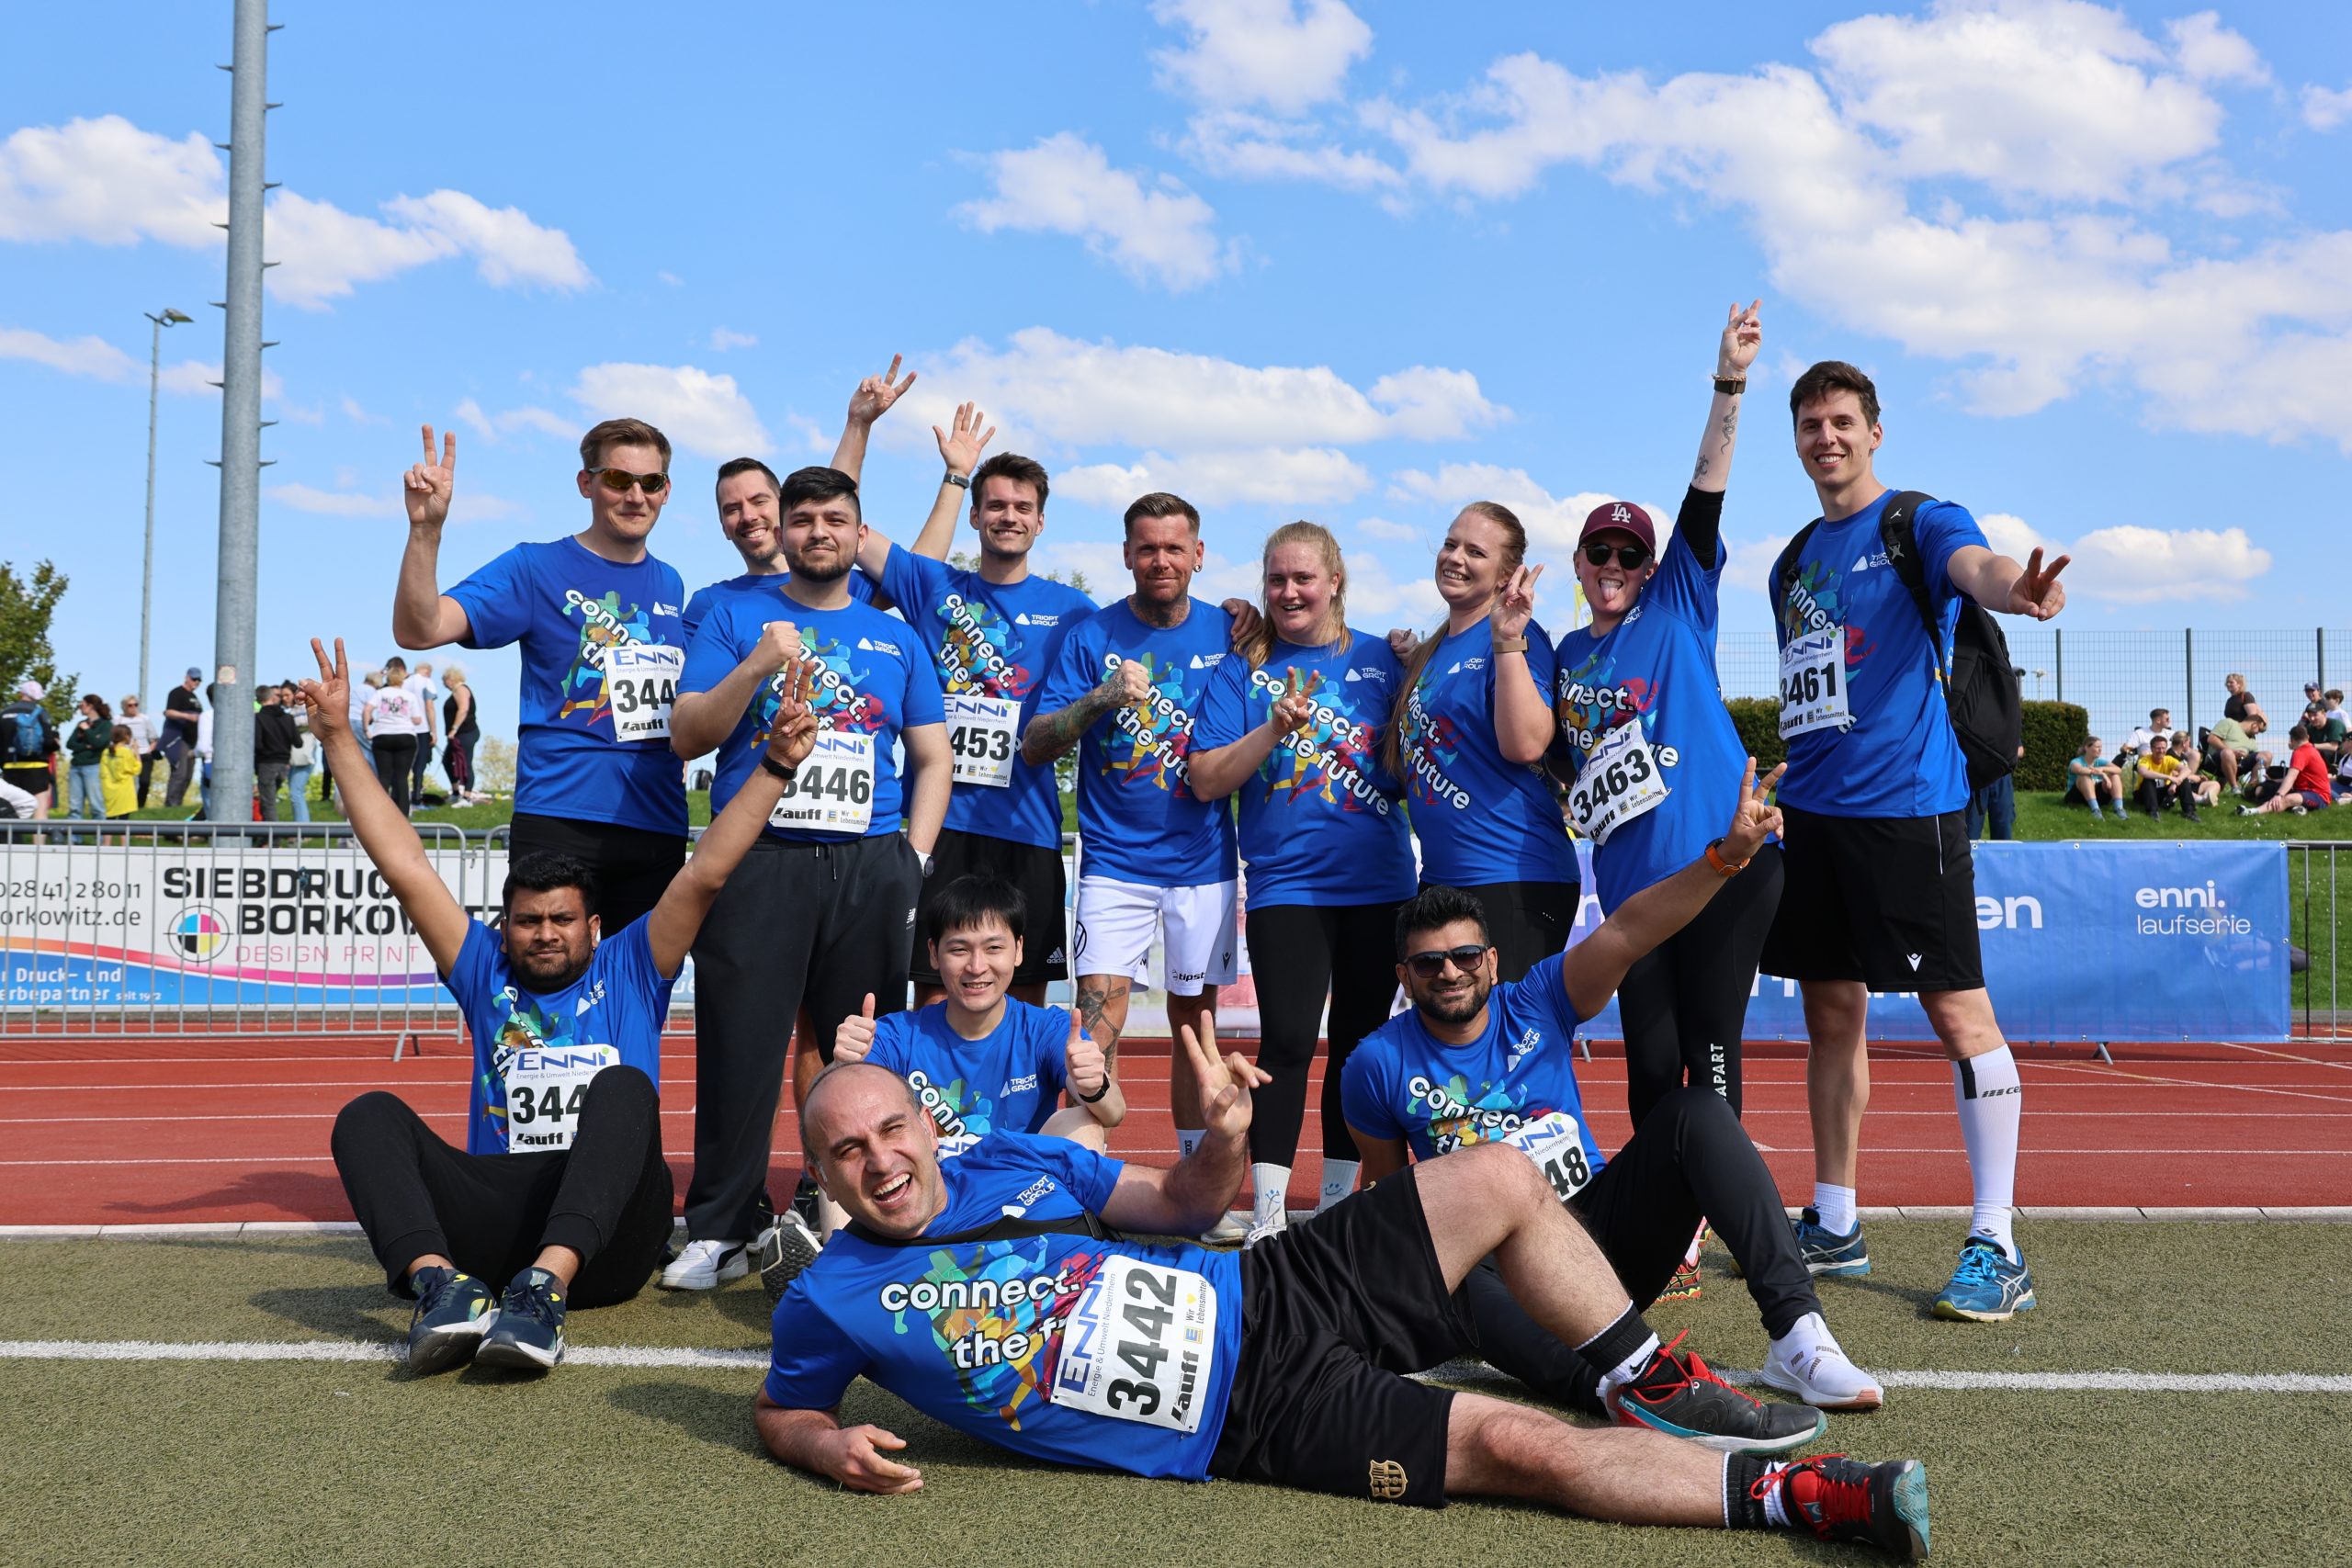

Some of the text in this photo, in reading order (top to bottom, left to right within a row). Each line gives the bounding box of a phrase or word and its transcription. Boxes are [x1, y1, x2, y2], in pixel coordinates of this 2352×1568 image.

[1611, 503, 1632, 524] LA
[1031, 615, 1059, 623] TRIOPT
[940, 643, 969, 683] the
[1780, 661, 1837, 713] 3461
[1115, 706, 1154, 747] the
[1250, 670, 1363, 750] conect.
[1317, 750, 1389, 816] future
[1410, 746, 1471, 810] future
[1573, 749, 1651, 824] 3463
[2137, 914, 2251, 935] laufserie
[235, 945, 420, 963] DESIGN PRNT
[516, 1073, 539, 1081] Energie
[1016, 1175, 1049, 1203] TRIOPT
[1024, 1181, 1056, 1207] GROUP
[880, 1269, 1080, 1313] connect.
[1195, 1280, 1207, 1325] Lebensmittel
[1185, 1308, 1195, 1321] Wir
[952, 1331, 1031, 1371] the
[1088, 1273, 1116, 1397] Energie & Umwelt Niederrhein
[1106, 1268, 1178, 1416] 3442
